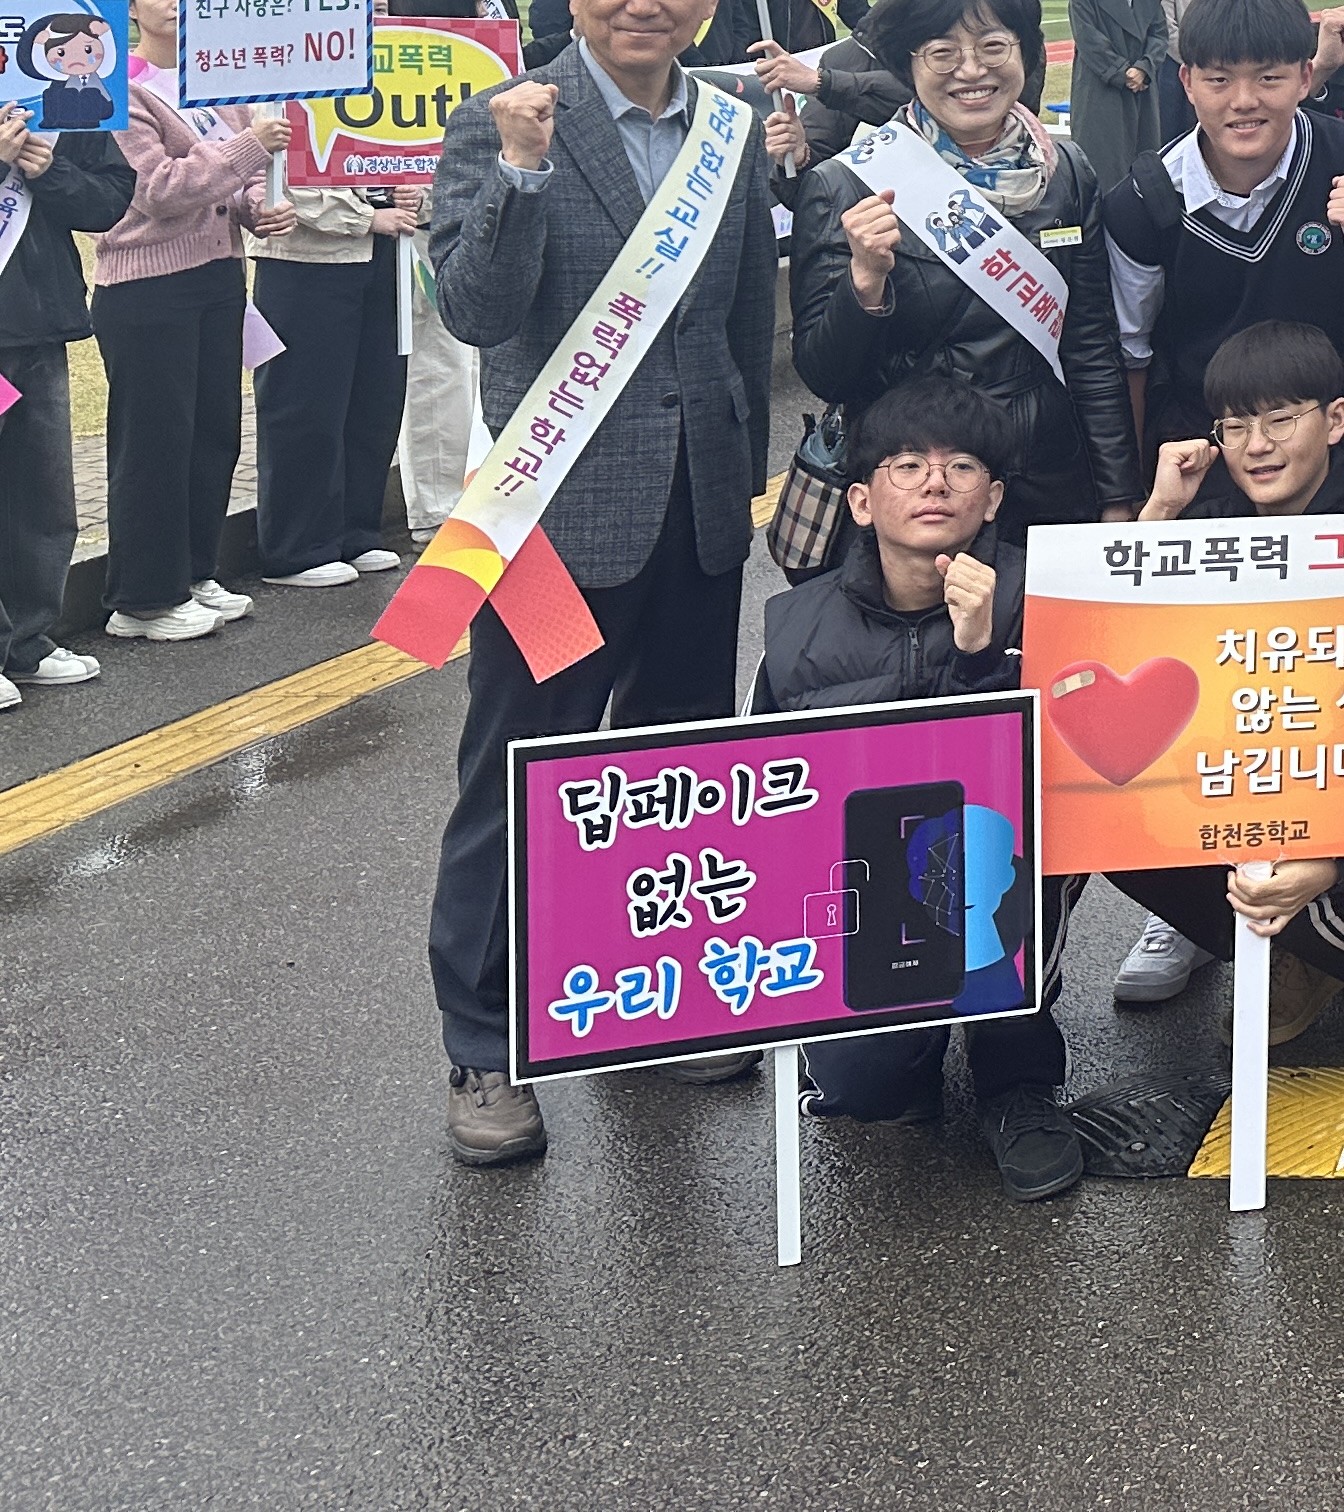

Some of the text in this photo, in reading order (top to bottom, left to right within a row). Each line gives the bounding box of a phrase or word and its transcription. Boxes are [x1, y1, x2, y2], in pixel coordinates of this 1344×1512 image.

[195, 28, 355, 72] 청소년 폭력? NO!
[1103, 534, 1289, 586] 학교폭력
[1232, 685, 1320, 734] 않는
[560, 760, 818, 849] 딥페이크
[1198, 819, 1311, 851] 합천중학교
[628, 854, 755, 935] 없는
[551, 938, 822, 1035] 우리 학교
